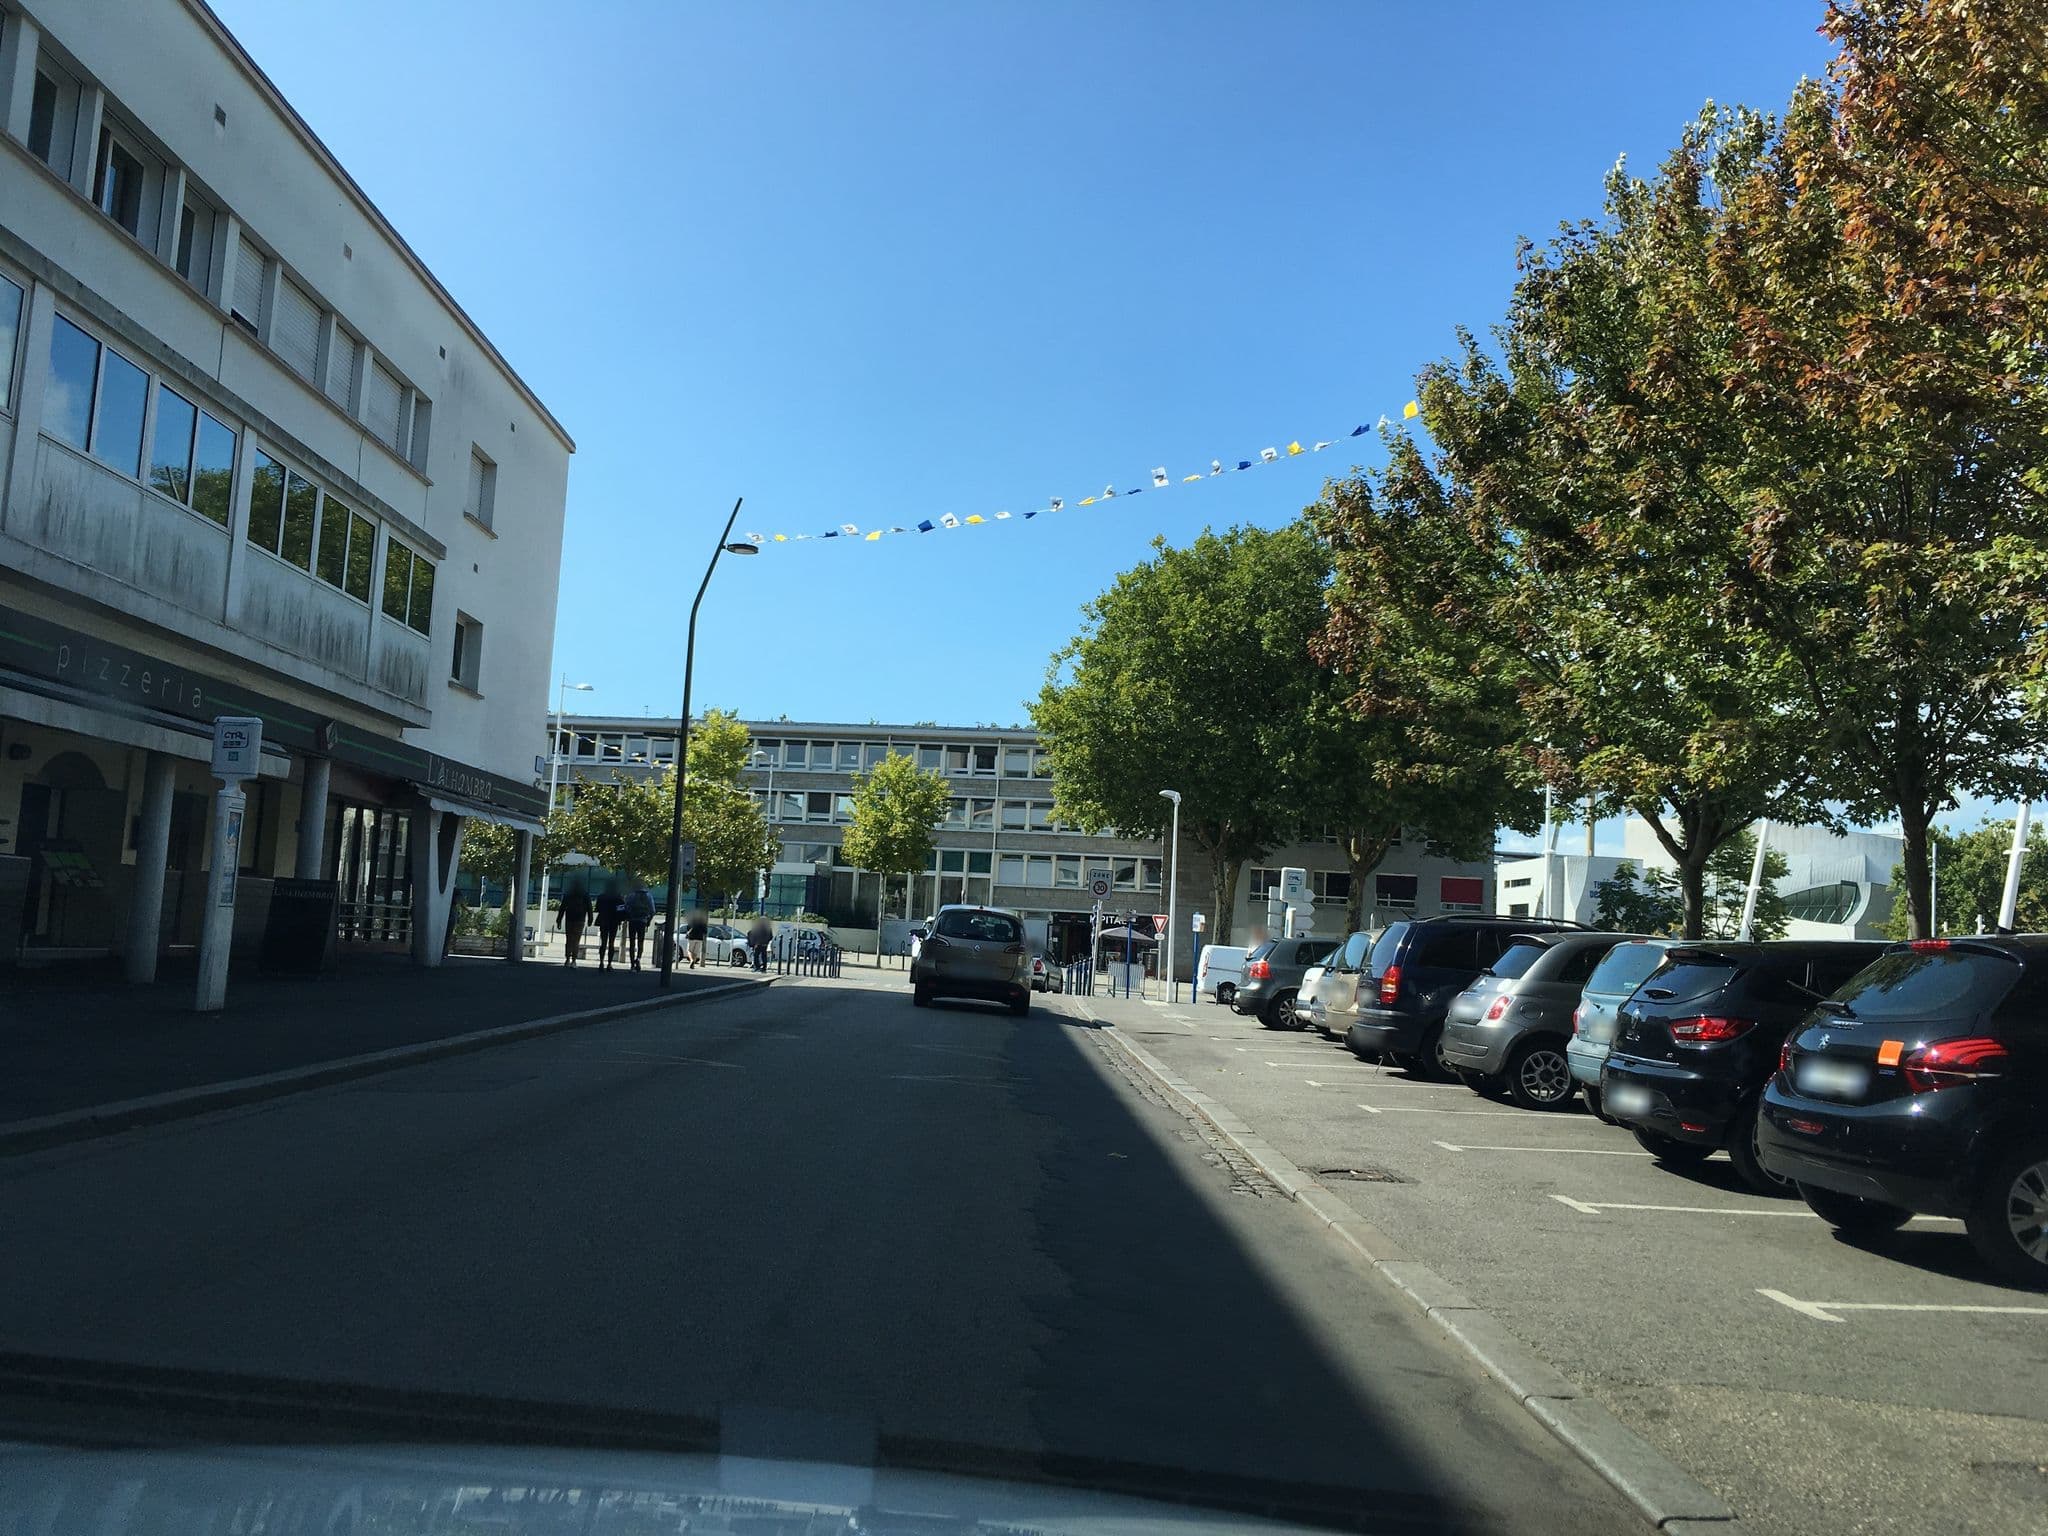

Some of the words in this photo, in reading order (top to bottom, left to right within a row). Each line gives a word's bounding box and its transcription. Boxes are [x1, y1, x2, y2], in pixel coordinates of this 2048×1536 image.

[57, 644, 202, 708] pizzeria
[1092, 871, 1110, 879] ZONE
[1096, 884, 1105, 892] 30
[1090, 915, 1128, 925] KPITAL
